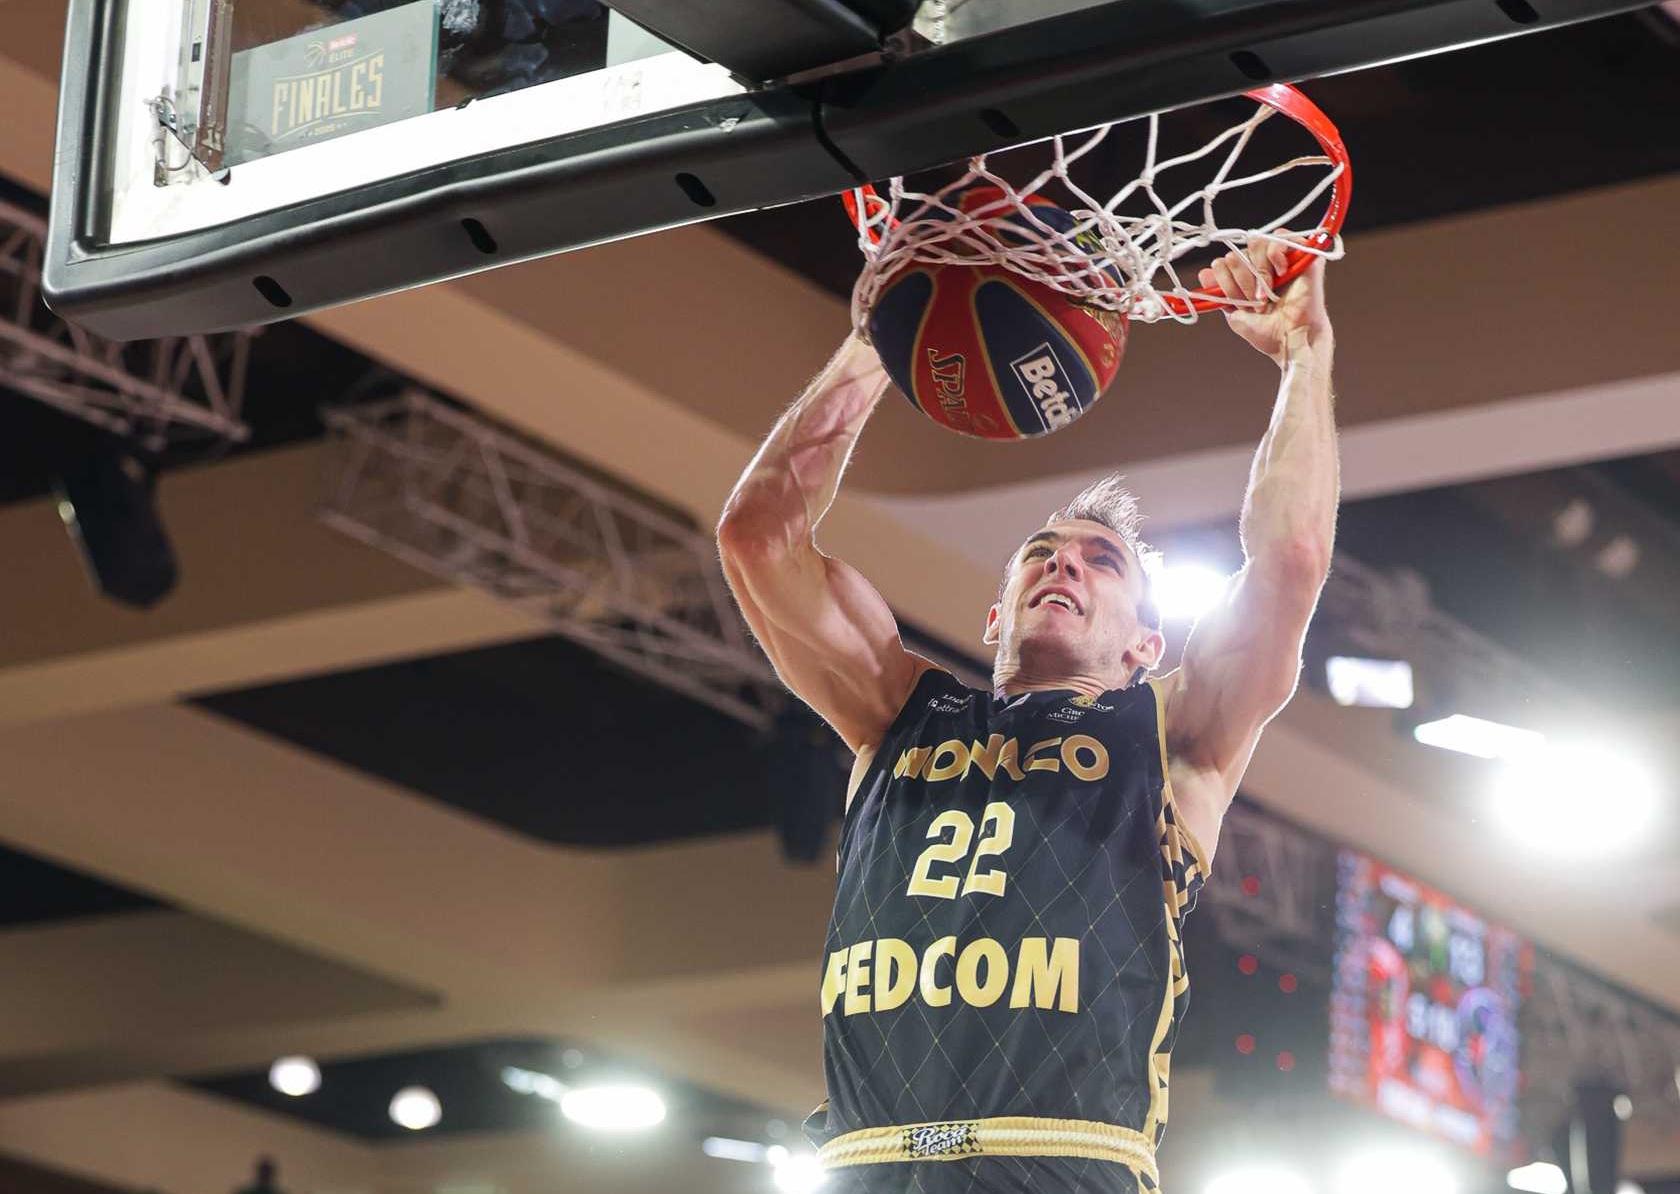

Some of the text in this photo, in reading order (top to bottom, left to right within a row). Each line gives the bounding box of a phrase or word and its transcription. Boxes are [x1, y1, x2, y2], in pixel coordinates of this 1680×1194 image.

[271, 54, 385, 135] FINALES
[893, 733, 1109, 782] MONACO
[906, 801, 1015, 900] 22
[820, 935, 1080, 1017] FEDCOM
[912, 1126, 968, 1150] Roca
